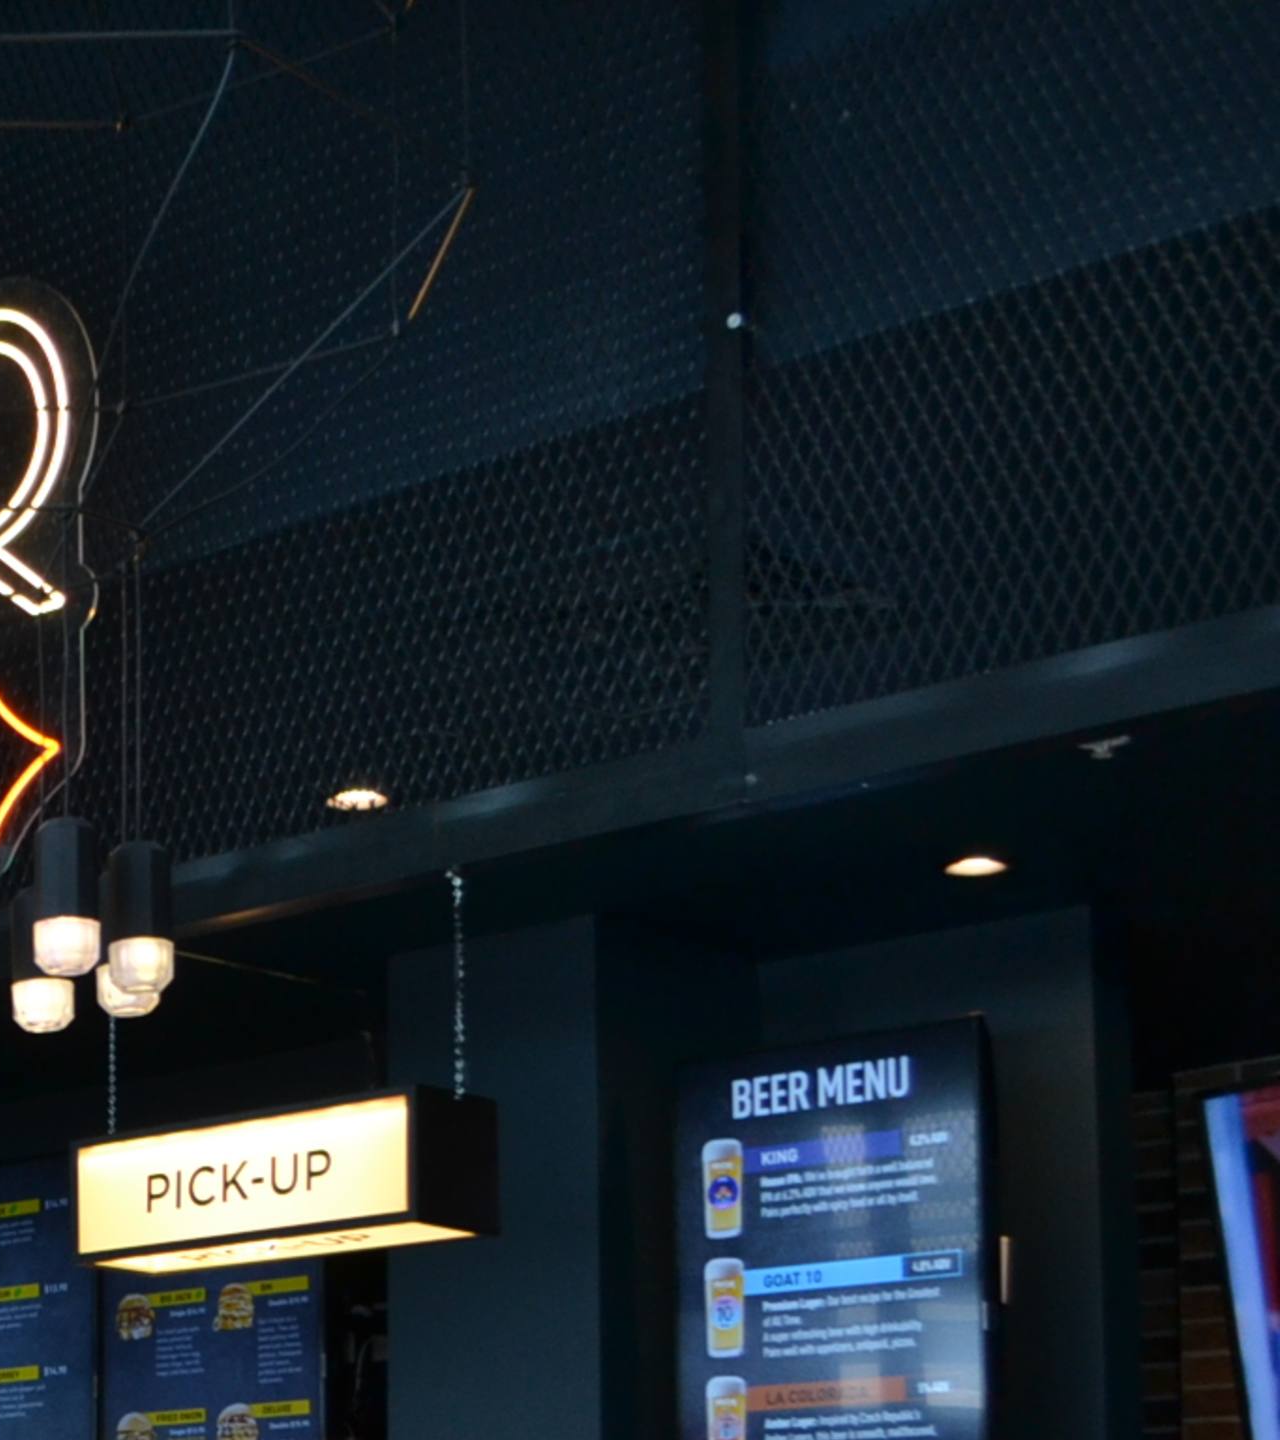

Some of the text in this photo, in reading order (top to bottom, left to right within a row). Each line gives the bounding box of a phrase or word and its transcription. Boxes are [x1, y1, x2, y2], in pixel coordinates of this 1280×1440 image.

[730, 1054, 911, 1121] BEER MENU
[759, 1147, 800, 1167] KING
[145, 1148, 333, 1214] PICK-UP
[762, 1269, 824, 1289] GOAT 10
[766, 1391, 785, 1406] LA
